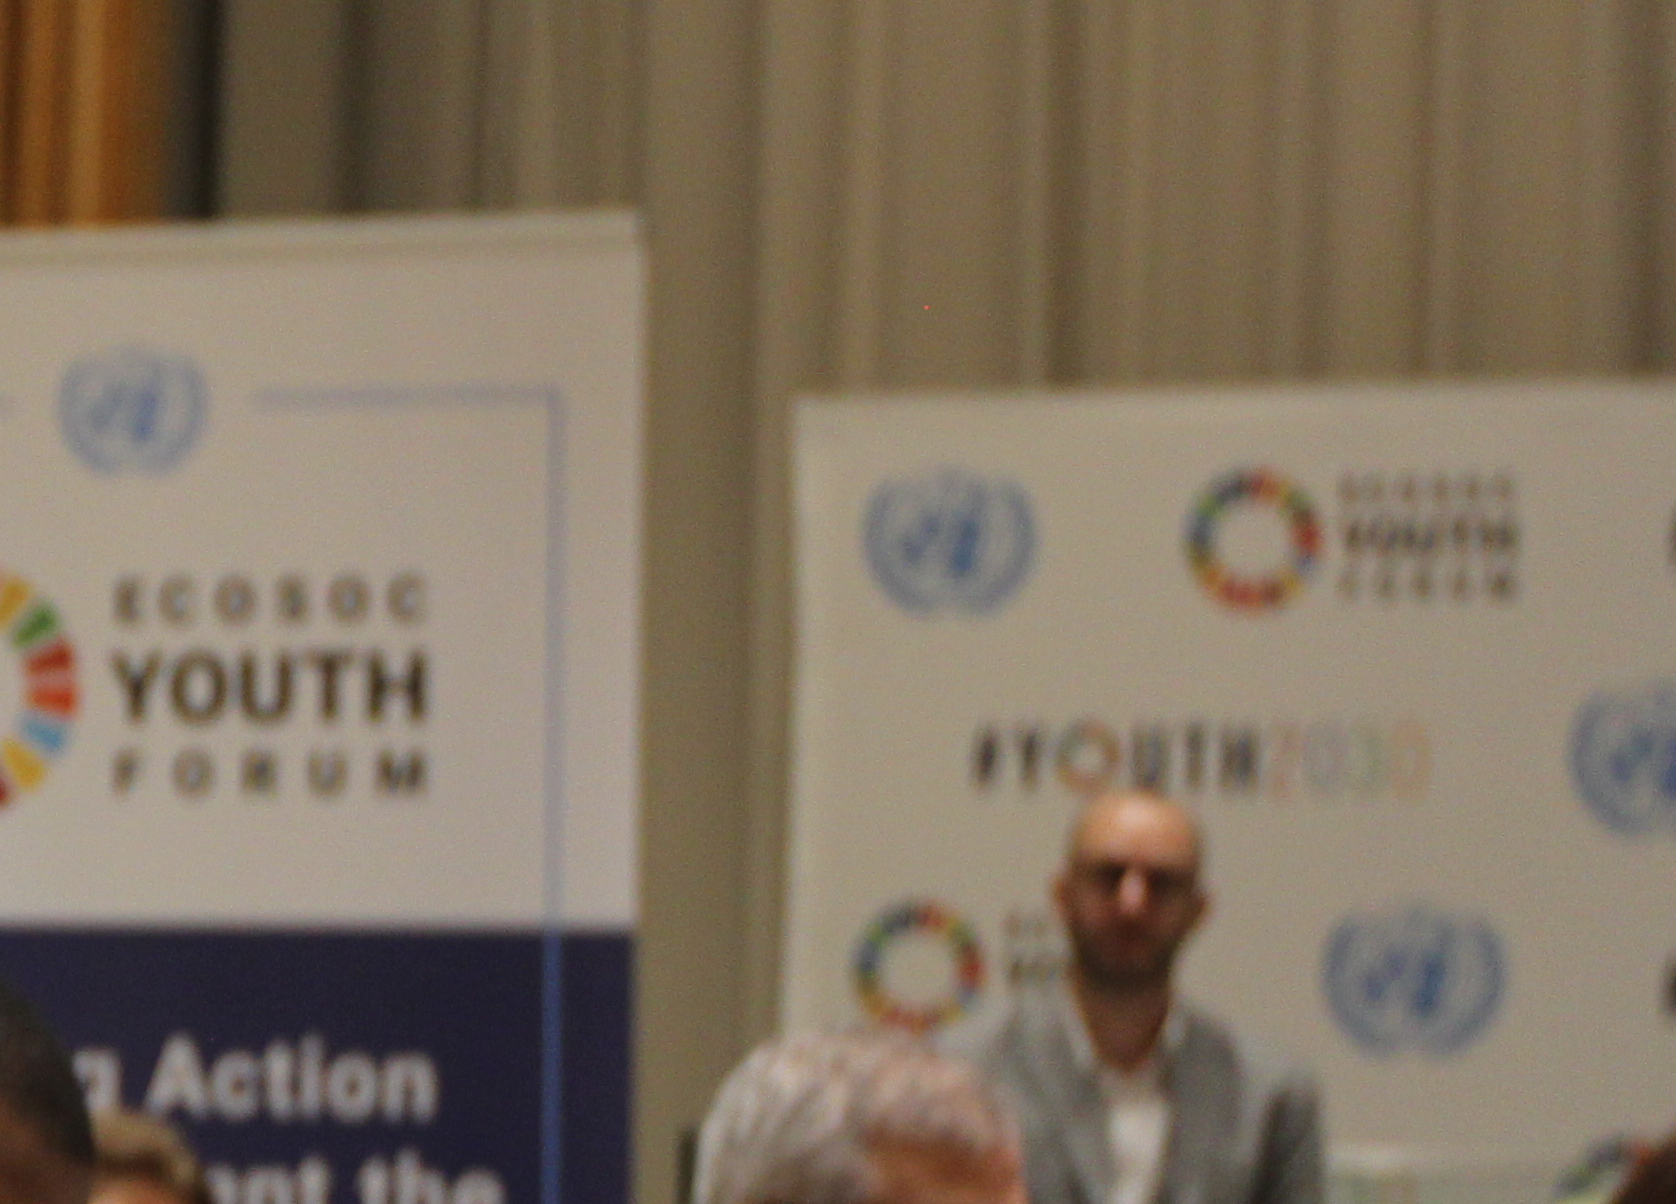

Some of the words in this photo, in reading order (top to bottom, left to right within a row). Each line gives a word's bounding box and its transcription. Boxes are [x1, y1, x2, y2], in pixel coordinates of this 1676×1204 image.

[111, 573, 428, 626] ECOSOC
[109, 649, 428, 726] YOUTH
[110, 749, 428, 800] FORUM
[147, 1031, 440, 1124] Action
